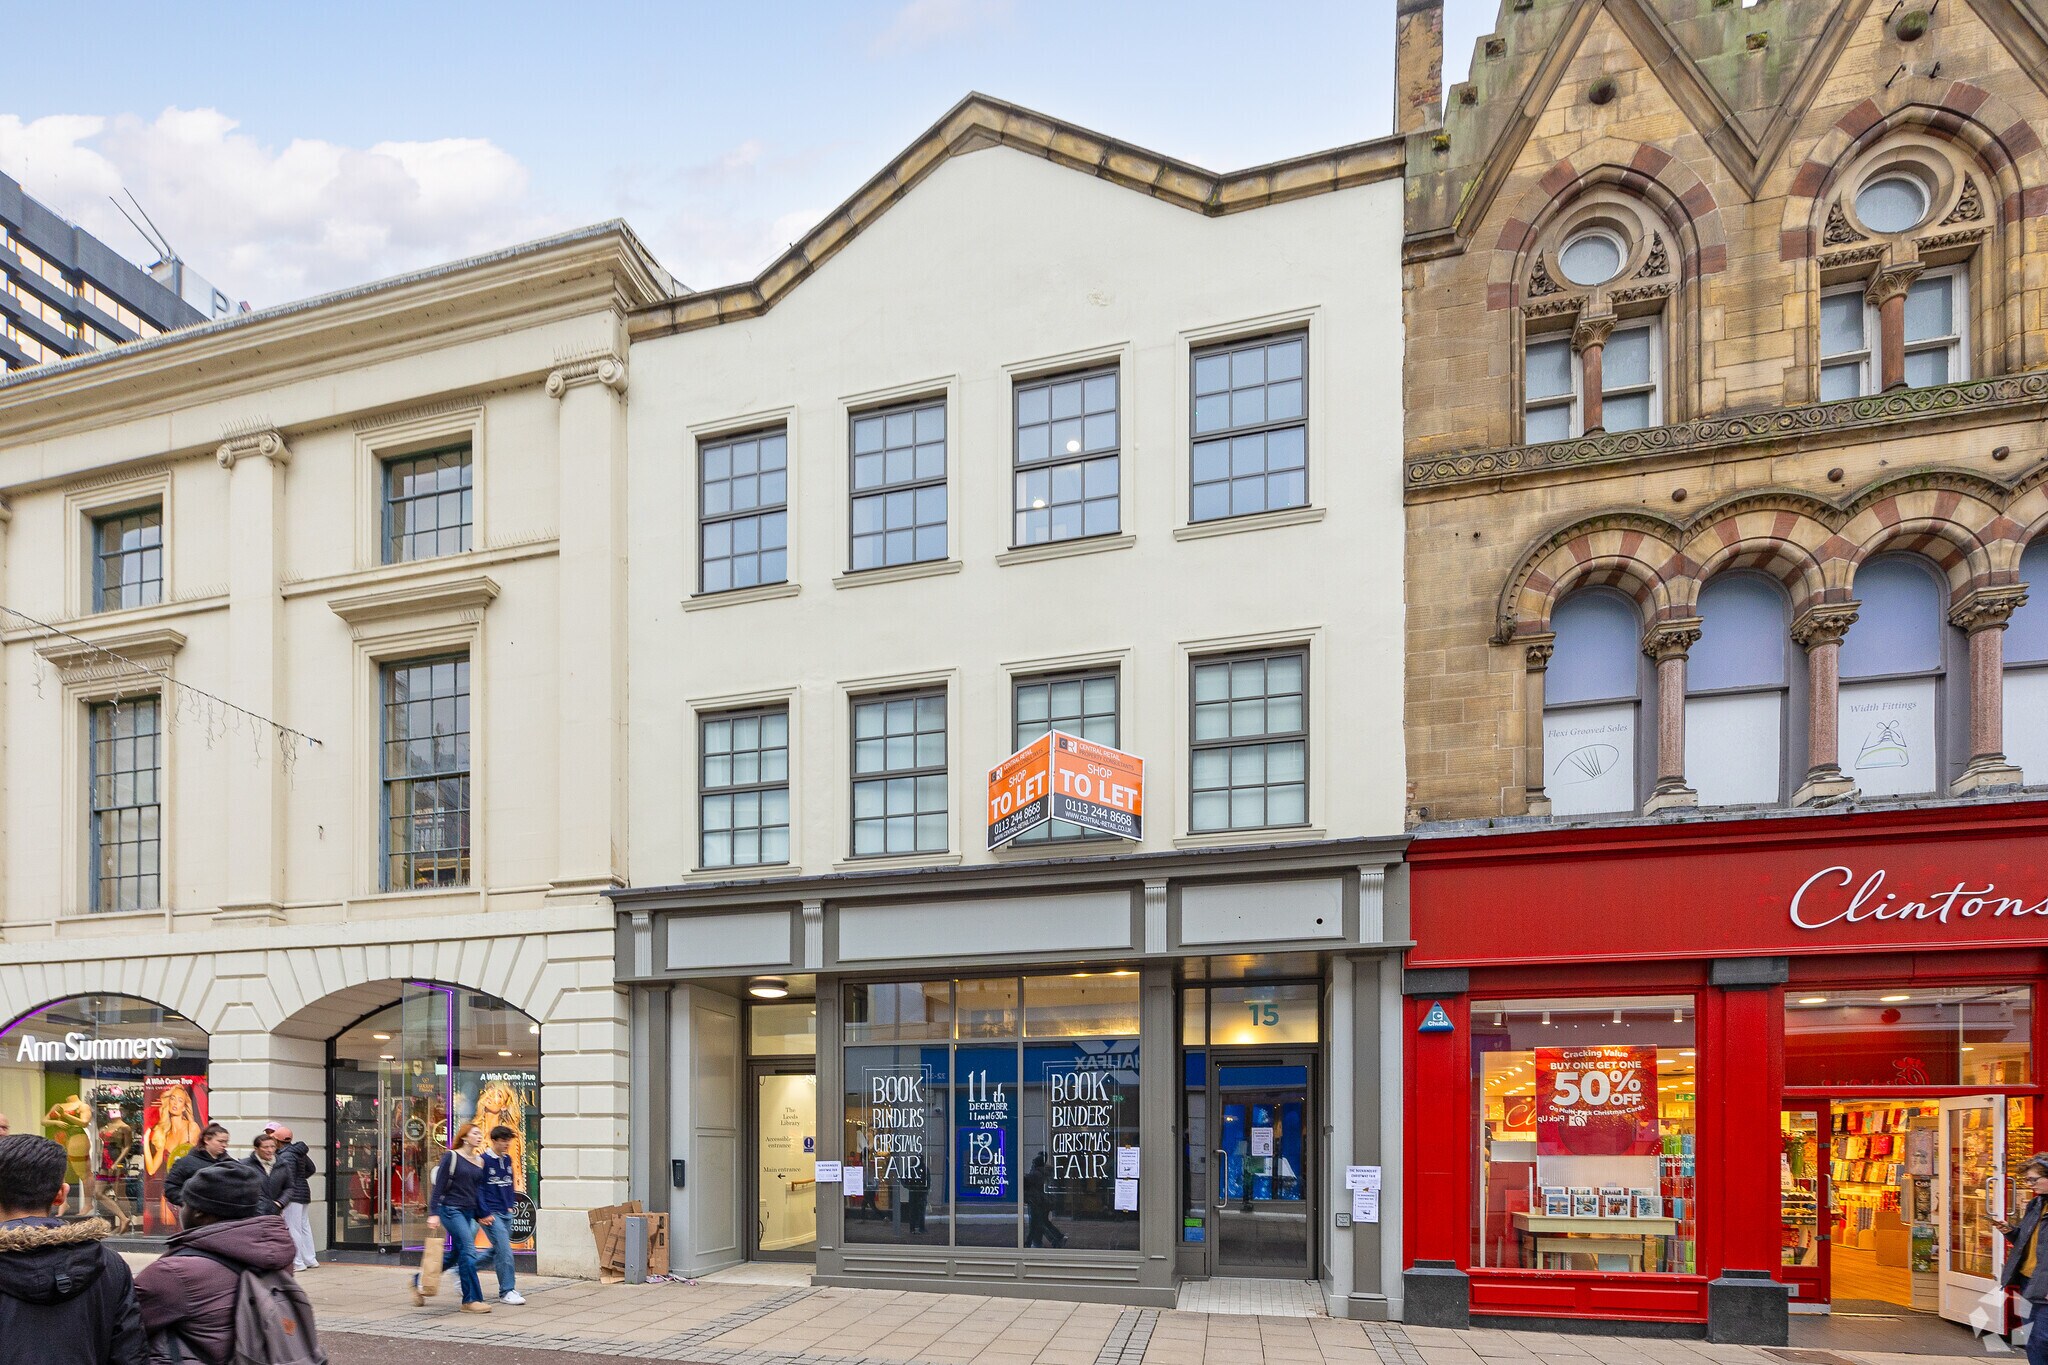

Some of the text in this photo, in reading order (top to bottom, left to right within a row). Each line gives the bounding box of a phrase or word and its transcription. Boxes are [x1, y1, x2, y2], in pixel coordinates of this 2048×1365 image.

[1851, 701, 1917, 712] Width Fittings
[1548, 724, 1628, 738] Flexi Grooved Soles
[1079, 743, 1121, 761] CENTRAL RETAIL
[1009, 769, 1026, 788] SHOP
[1087, 763, 1113, 778] SHOP
[991, 770, 1046, 820] TO LET
[1059, 768, 1138, 810] TO LET
[994, 801, 1041, 835] 0113 244 8668
[1065, 798, 1132, 826] 0113 244 8668
[1065, 810, 1132, 834] WWW.CENTRAL-RETAIL.CO.UK
[1249, 1004, 1279, 1026] 15
[16, 1032, 170, 1062] Ann Summers
[1563, 1049, 1629, 1059] Cracking Value
[1550, 1062, 1570, 1070] BUY
[1596, 1061, 1617, 1069] GET
[1619, 1061, 1642, 1069] ONE
[145, 1077, 193, 1085] A Wish Come True
[480, 1072, 536, 1081] A Wish Come True
[872, 1076, 924, 1103] BOOK
[1051, 1072, 1110, 1102] BOOK
[1552, 1070, 1641, 1106] 50%
[969, 1102, 1008, 1111] DECEMBER
[1549, 1105, 1559, 1113] On
[1626, 1104, 1645, 1113] Cards
[1610, 1093, 1642, 1106] OFF
[980, 1121, 999, 1129] 2025
[873, 1133, 923, 1153] CHRISTMAS
[969, 1132, 1005, 1165] 18th
[1053, 1132, 1111, 1153] CHRISTMAS
[874, 1155, 921, 1179] FAIR
[969, 1165, 1007, 1176] DECEMBER
[1053, 1154, 1109, 1180] FAIR
[980, 1186, 999, 1195] 2025
